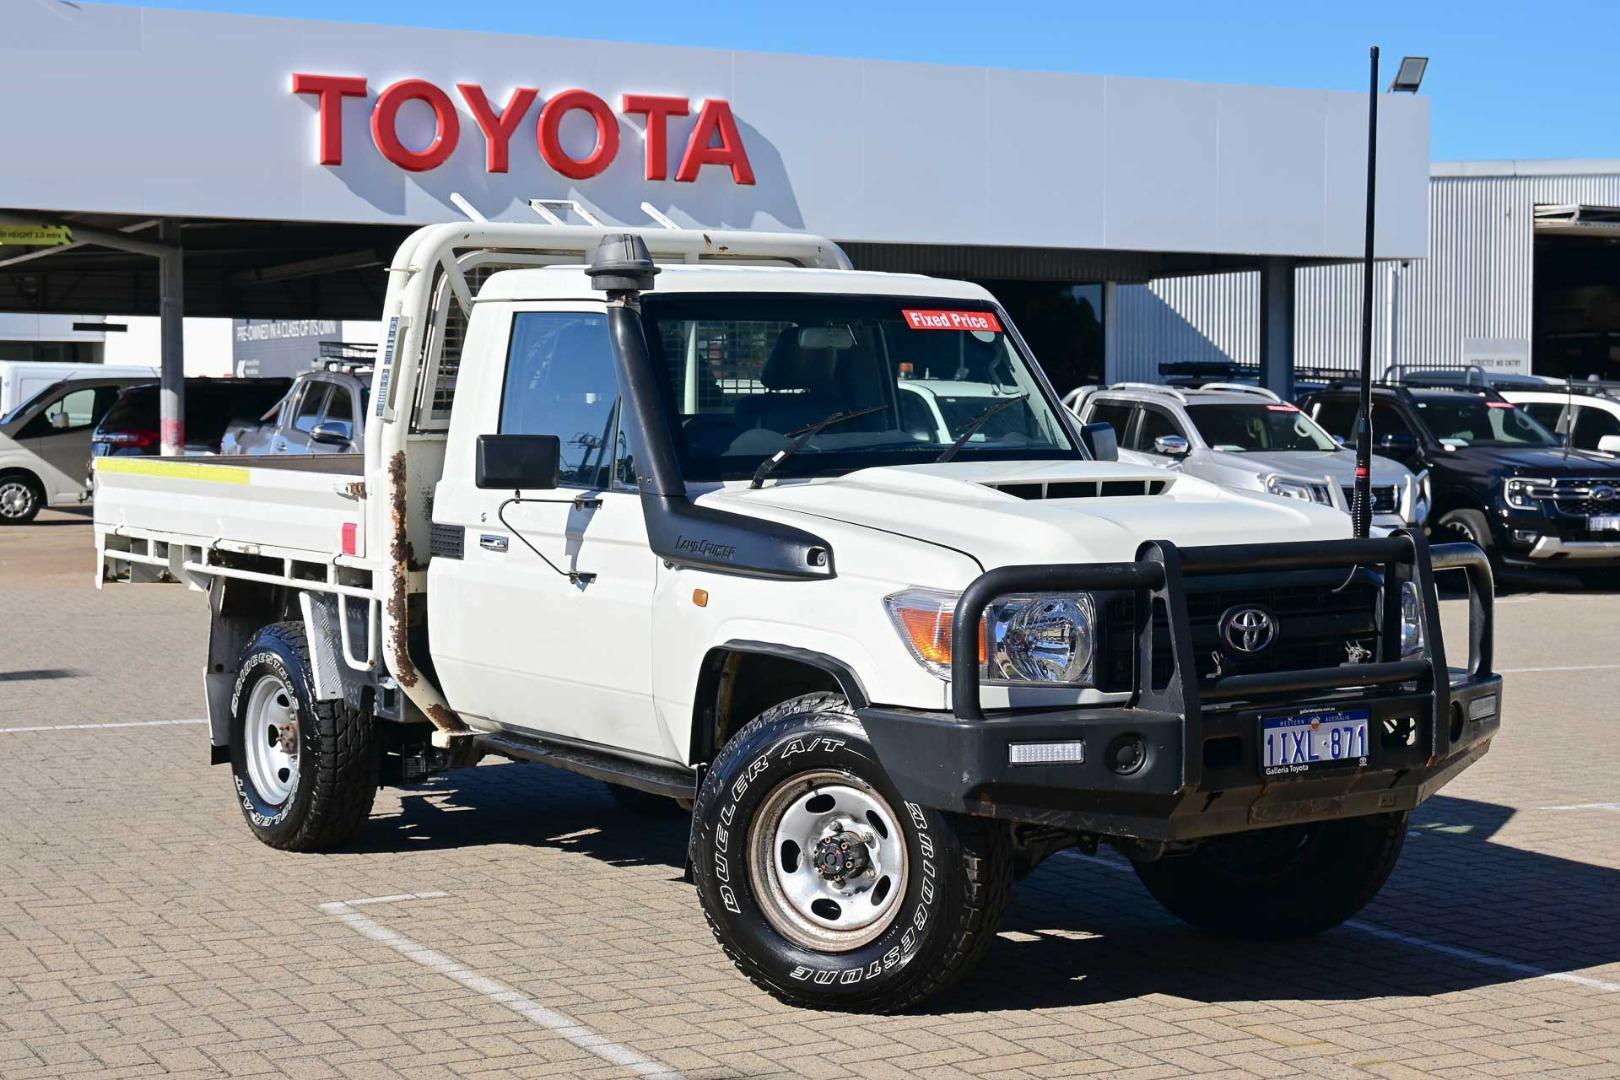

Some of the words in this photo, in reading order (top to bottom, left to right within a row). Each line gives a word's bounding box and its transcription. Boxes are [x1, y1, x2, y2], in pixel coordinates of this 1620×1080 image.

[292, 73, 756, 185] TOYOTA
[237, 323, 269, 341] PRE-OWNED
[319, 319, 336, 335] OWN
[909, 312, 952, 328] Fixed
[950, 313, 989, 329] Price
[1265, 767, 1289, 776] Galleria
[1290, 764, 1309, 775] Toyota
[716, 755, 769, 914] DUELER
[781, 738, 846, 760] A/T
[790, 801, 936, 985] BRIDGESTONE
